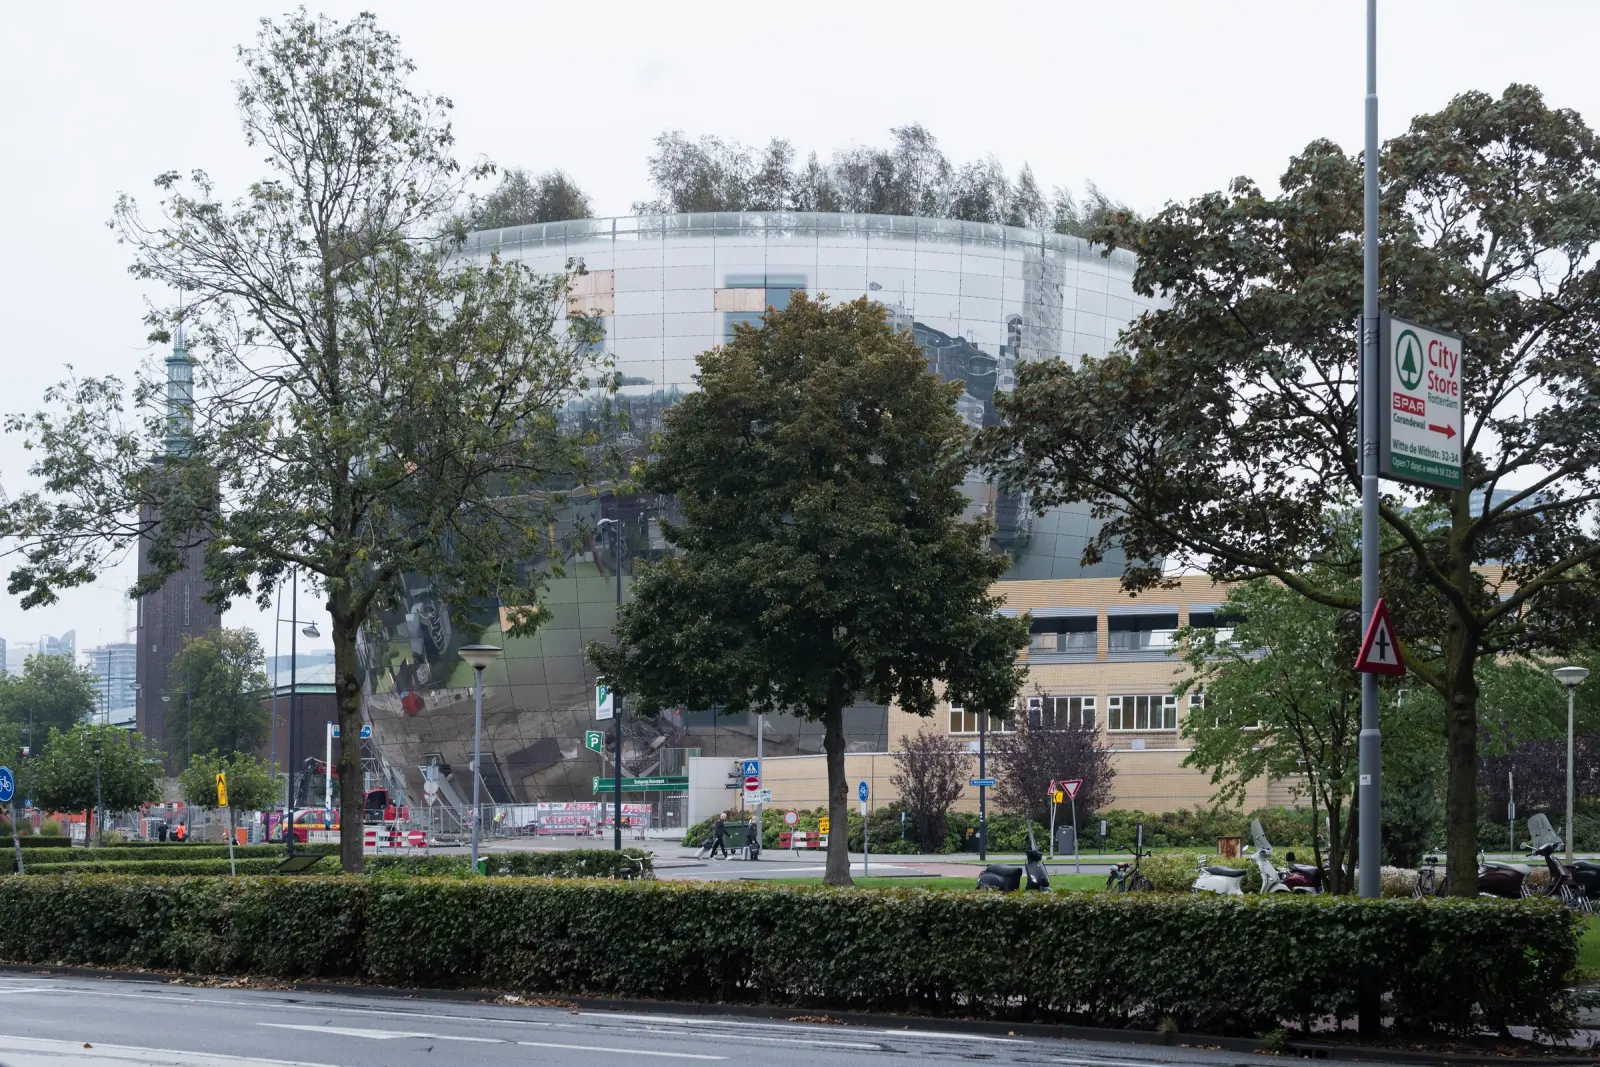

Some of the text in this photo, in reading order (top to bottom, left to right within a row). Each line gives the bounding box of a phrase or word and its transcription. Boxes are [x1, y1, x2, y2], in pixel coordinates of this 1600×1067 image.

[1428, 340, 1458, 378] City
[1428, 369, 1458, 396] Store
[1394, 395, 1424, 414] SPAR
[1428, 392, 1458, 409] Rotterdam
[1393, 413, 1426, 430] Corandewal
[1392, 438, 1459, 463] Witte de Withstr. 32-34
[1392, 456, 1406, 468] Open
[1410, 460, 1421, 473] days
[1426, 465, 1439, 474] week
